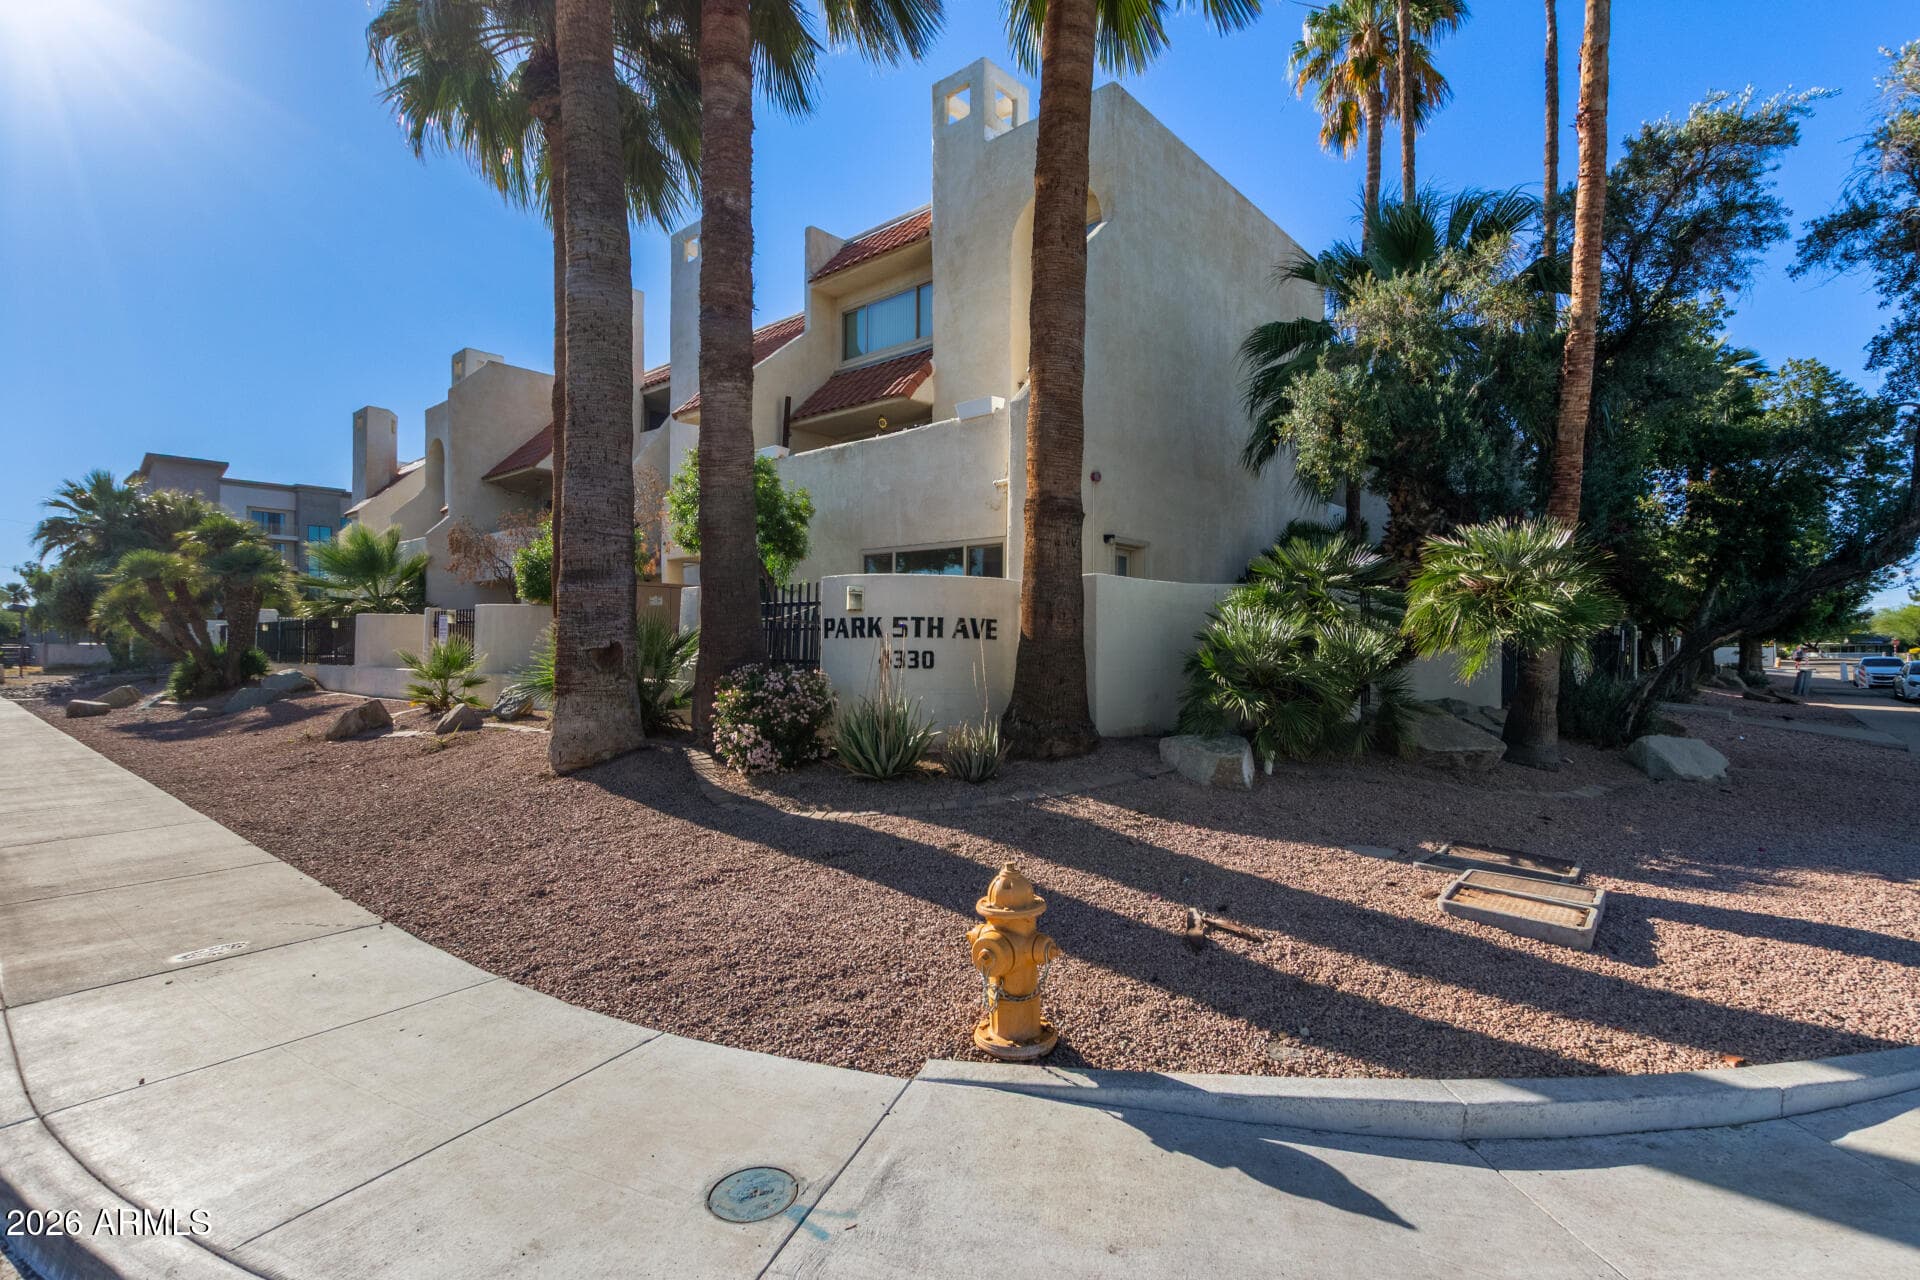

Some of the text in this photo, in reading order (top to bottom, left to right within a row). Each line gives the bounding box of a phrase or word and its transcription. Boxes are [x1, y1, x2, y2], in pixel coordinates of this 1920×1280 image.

[824, 616, 998, 640] PARK 5TH AVE
[879, 650, 935, 669] 330
